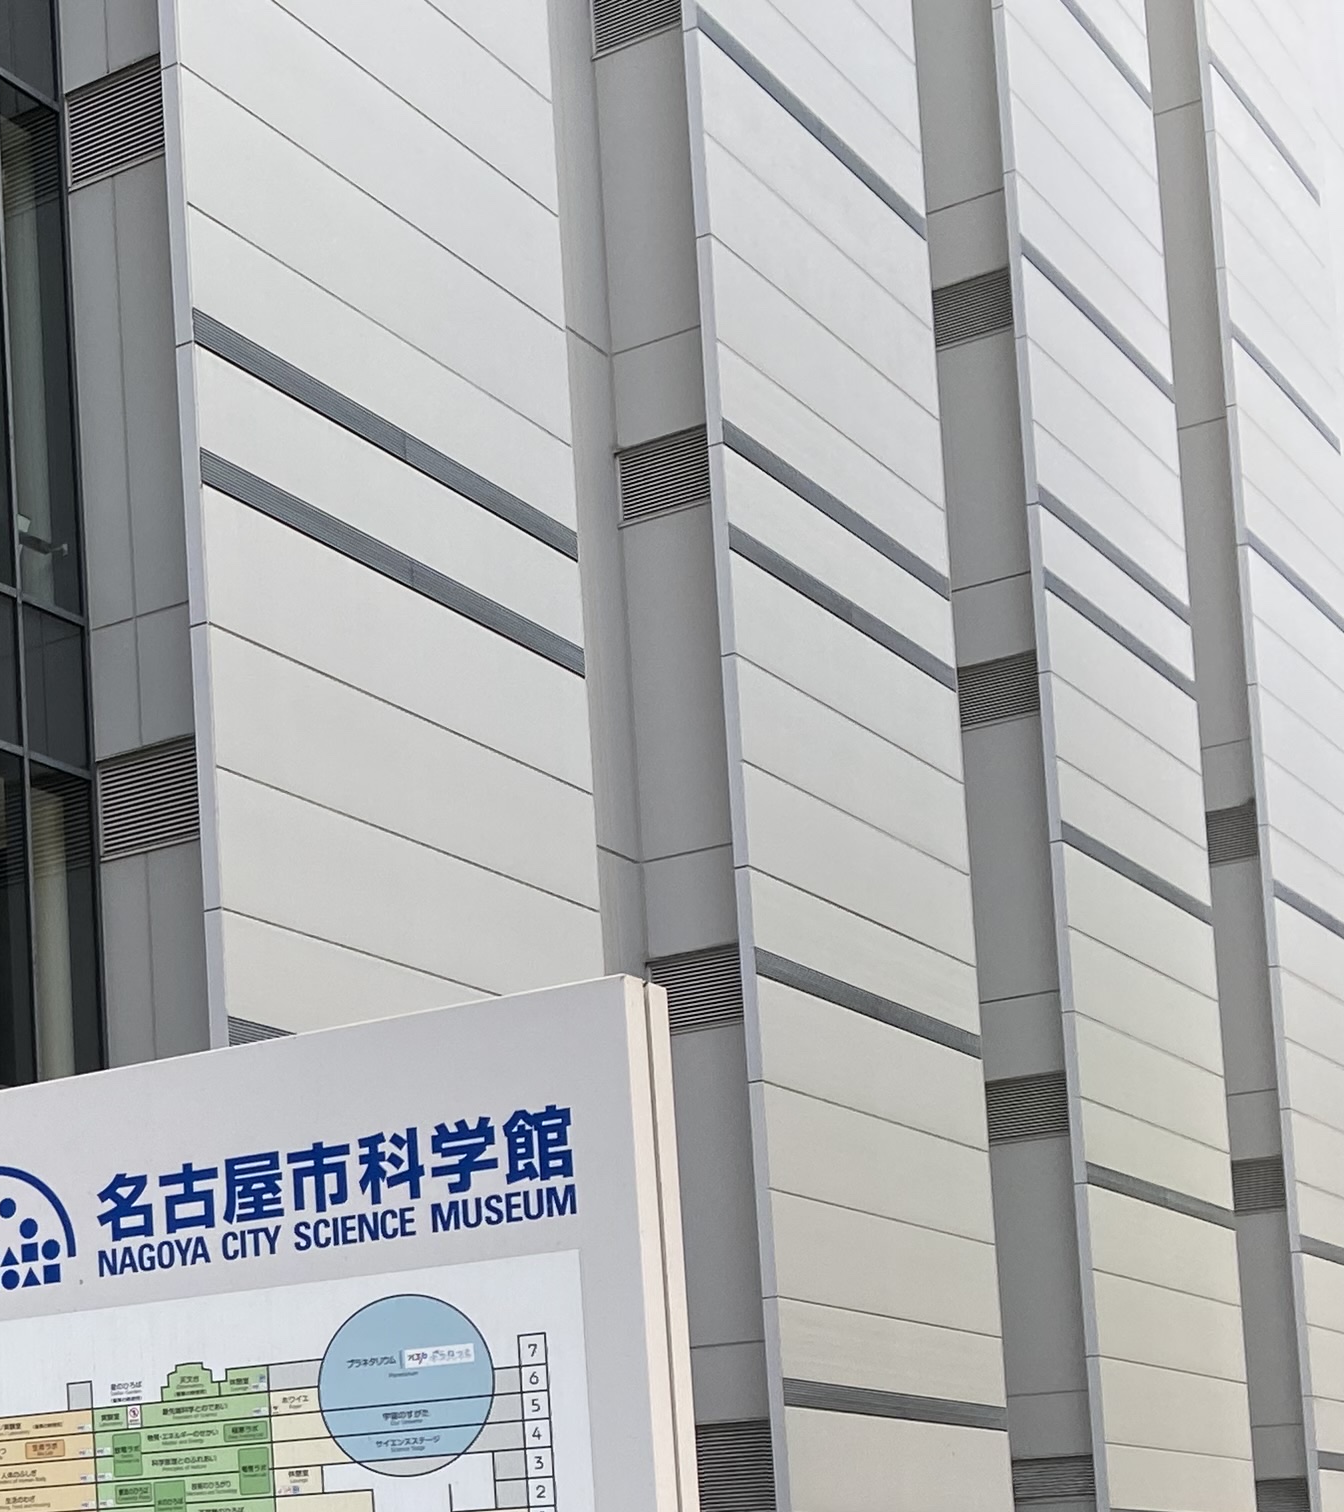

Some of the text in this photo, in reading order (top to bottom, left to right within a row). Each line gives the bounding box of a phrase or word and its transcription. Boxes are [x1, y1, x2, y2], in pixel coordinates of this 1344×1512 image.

[96, 1105, 575, 1243] 名古屋市科学館
[97, 1184, 578, 1278] NAGOYA CITY SCIENCE MUSEUM
[528, 1343, 537, 1357] 7
[529, 1371, 539, 1385] 6
[531, 1399, 541, 1413] 5
[532, 1427, 542, 1440] 4
[534, 1456, 544, 1470] 3
[536, 1485, 546, 1499] 2
